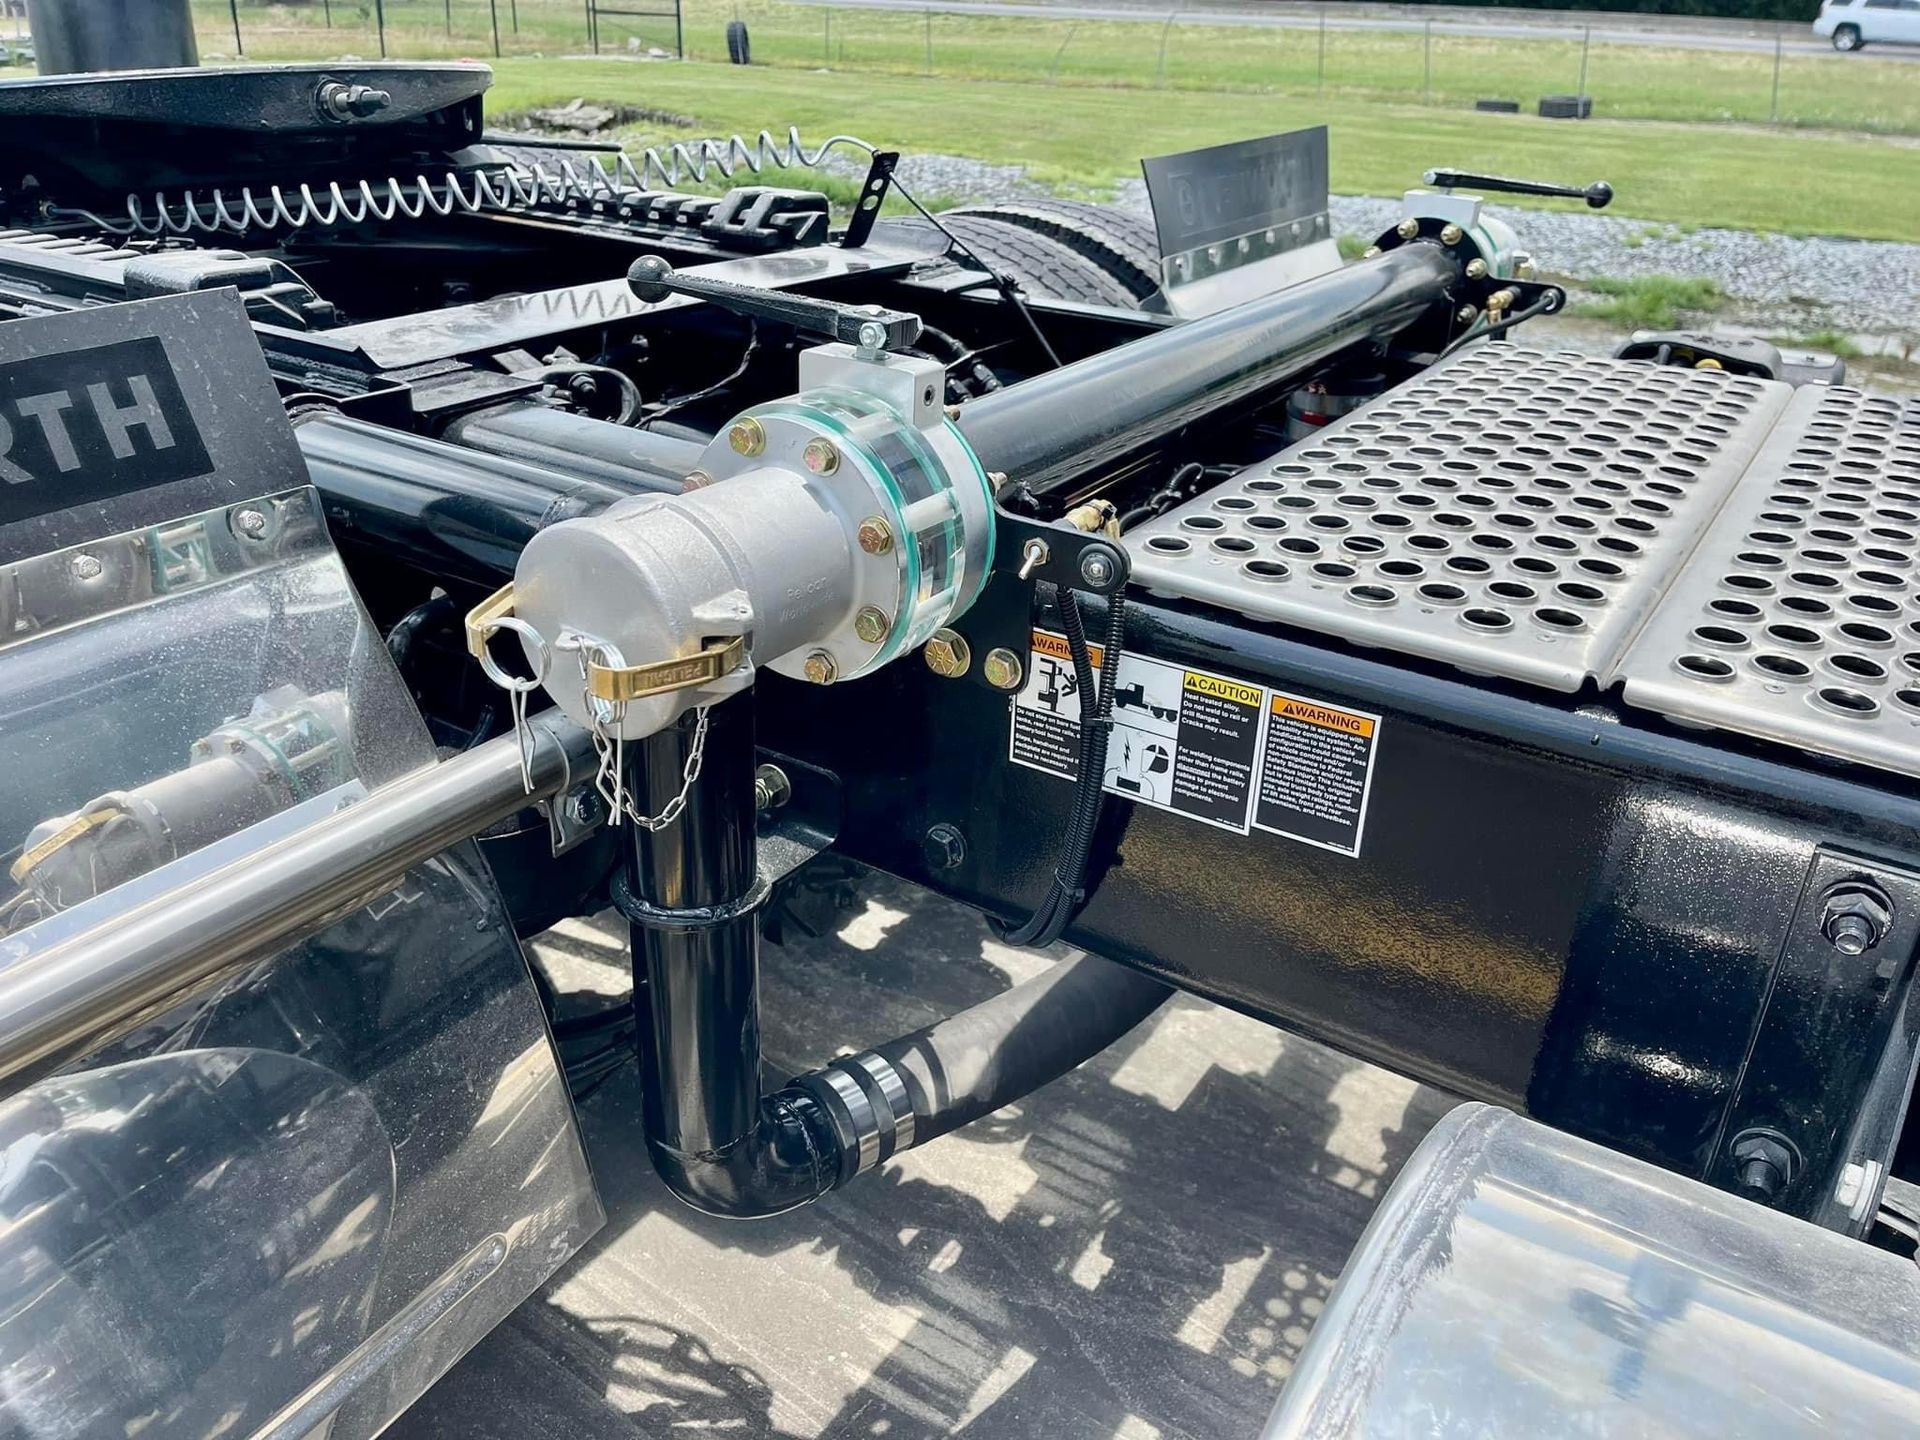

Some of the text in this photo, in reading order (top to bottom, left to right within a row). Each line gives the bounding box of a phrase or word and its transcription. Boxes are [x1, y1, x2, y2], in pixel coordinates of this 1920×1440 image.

[1036, 637, 1093, 661] WARNG
[1199, 679, 1259, 703] CAUTION
[1296, 706, 1360, 730] WARNING
